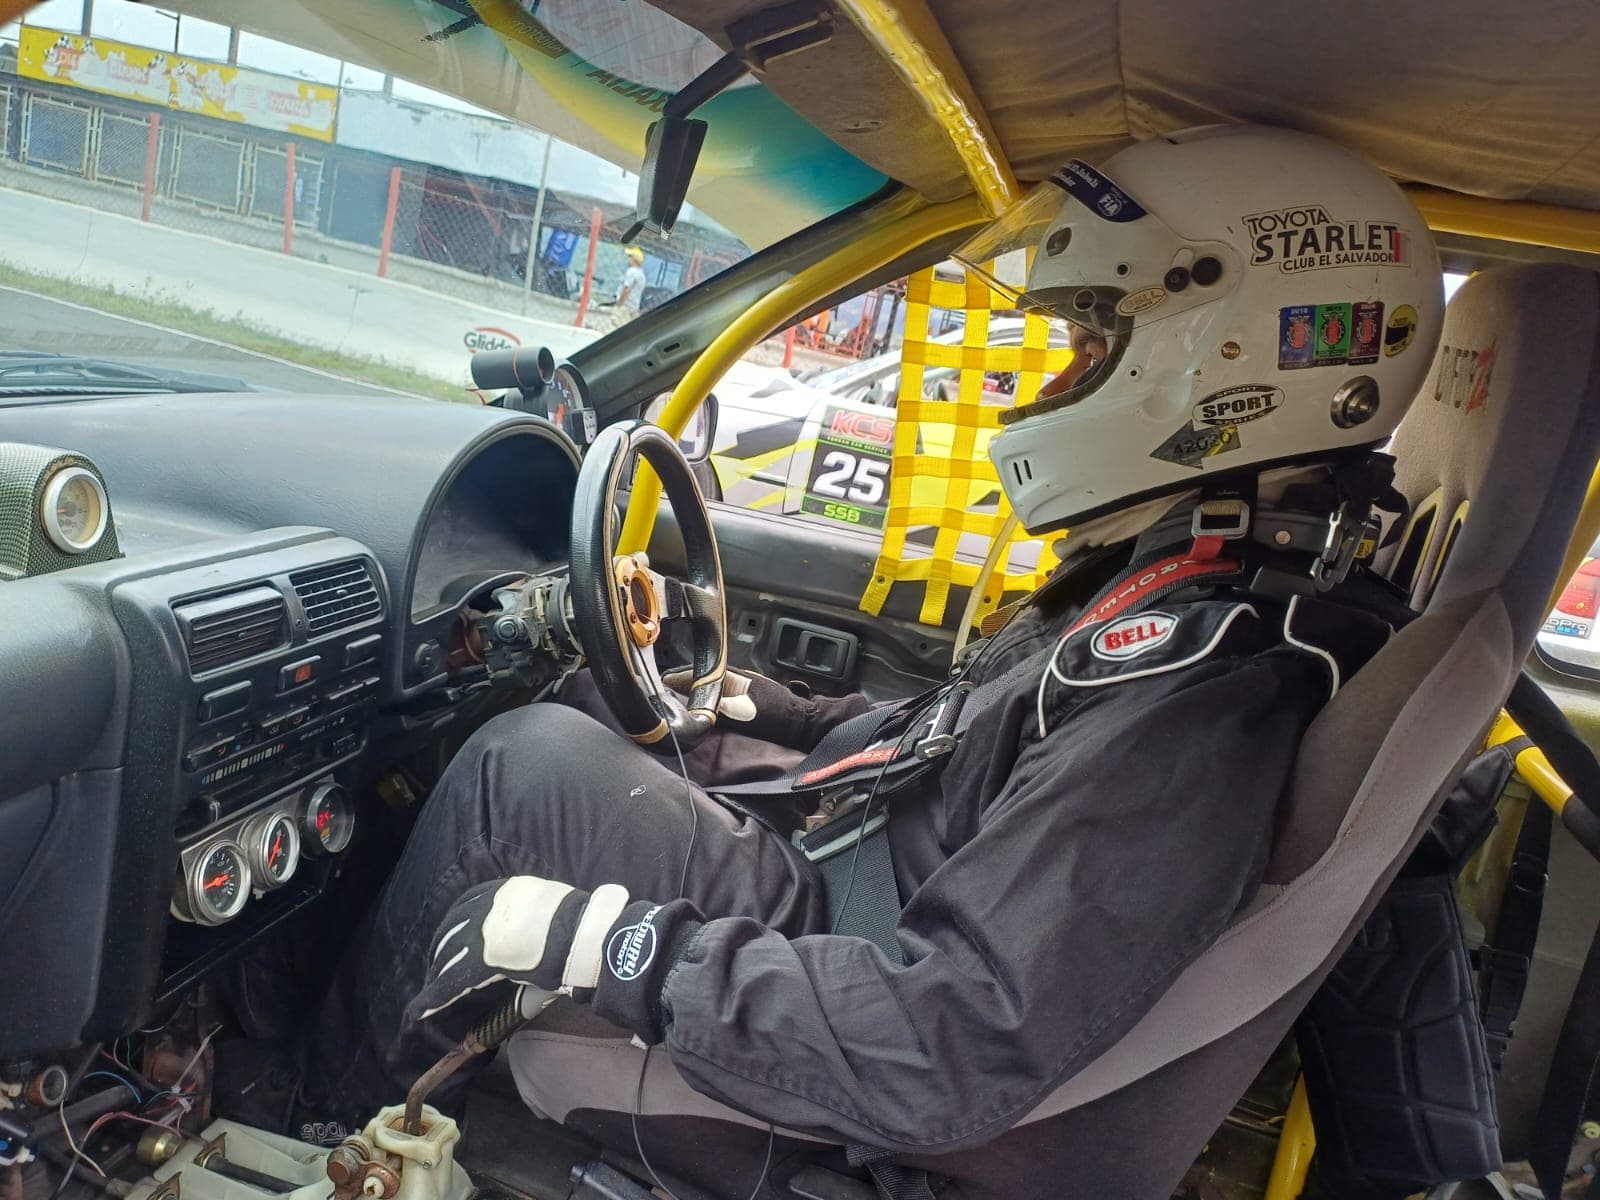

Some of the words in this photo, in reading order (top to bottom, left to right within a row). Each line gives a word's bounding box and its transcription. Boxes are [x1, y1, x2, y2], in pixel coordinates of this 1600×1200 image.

[1099, 194, 1119, 216] FIA
[1248, 208, 1330, 234] TOYOTA
[1255, 224, 1398, 262] STARLET
[1283, 256, 1316, 271] CLUB
[1319, 254, 1332, 266] EL
[1335, 252, 1394, 264] SALVADOR
[1202, 393, 1275, 418] SPORT
[832, 410, 894, 444] KCS
[812, 451, 891, 504] 25
[824, 504, 860, 523] SSB
[1104, 621, 1168, 650] BELL
[1549, 619, 1587, 631] oPro
